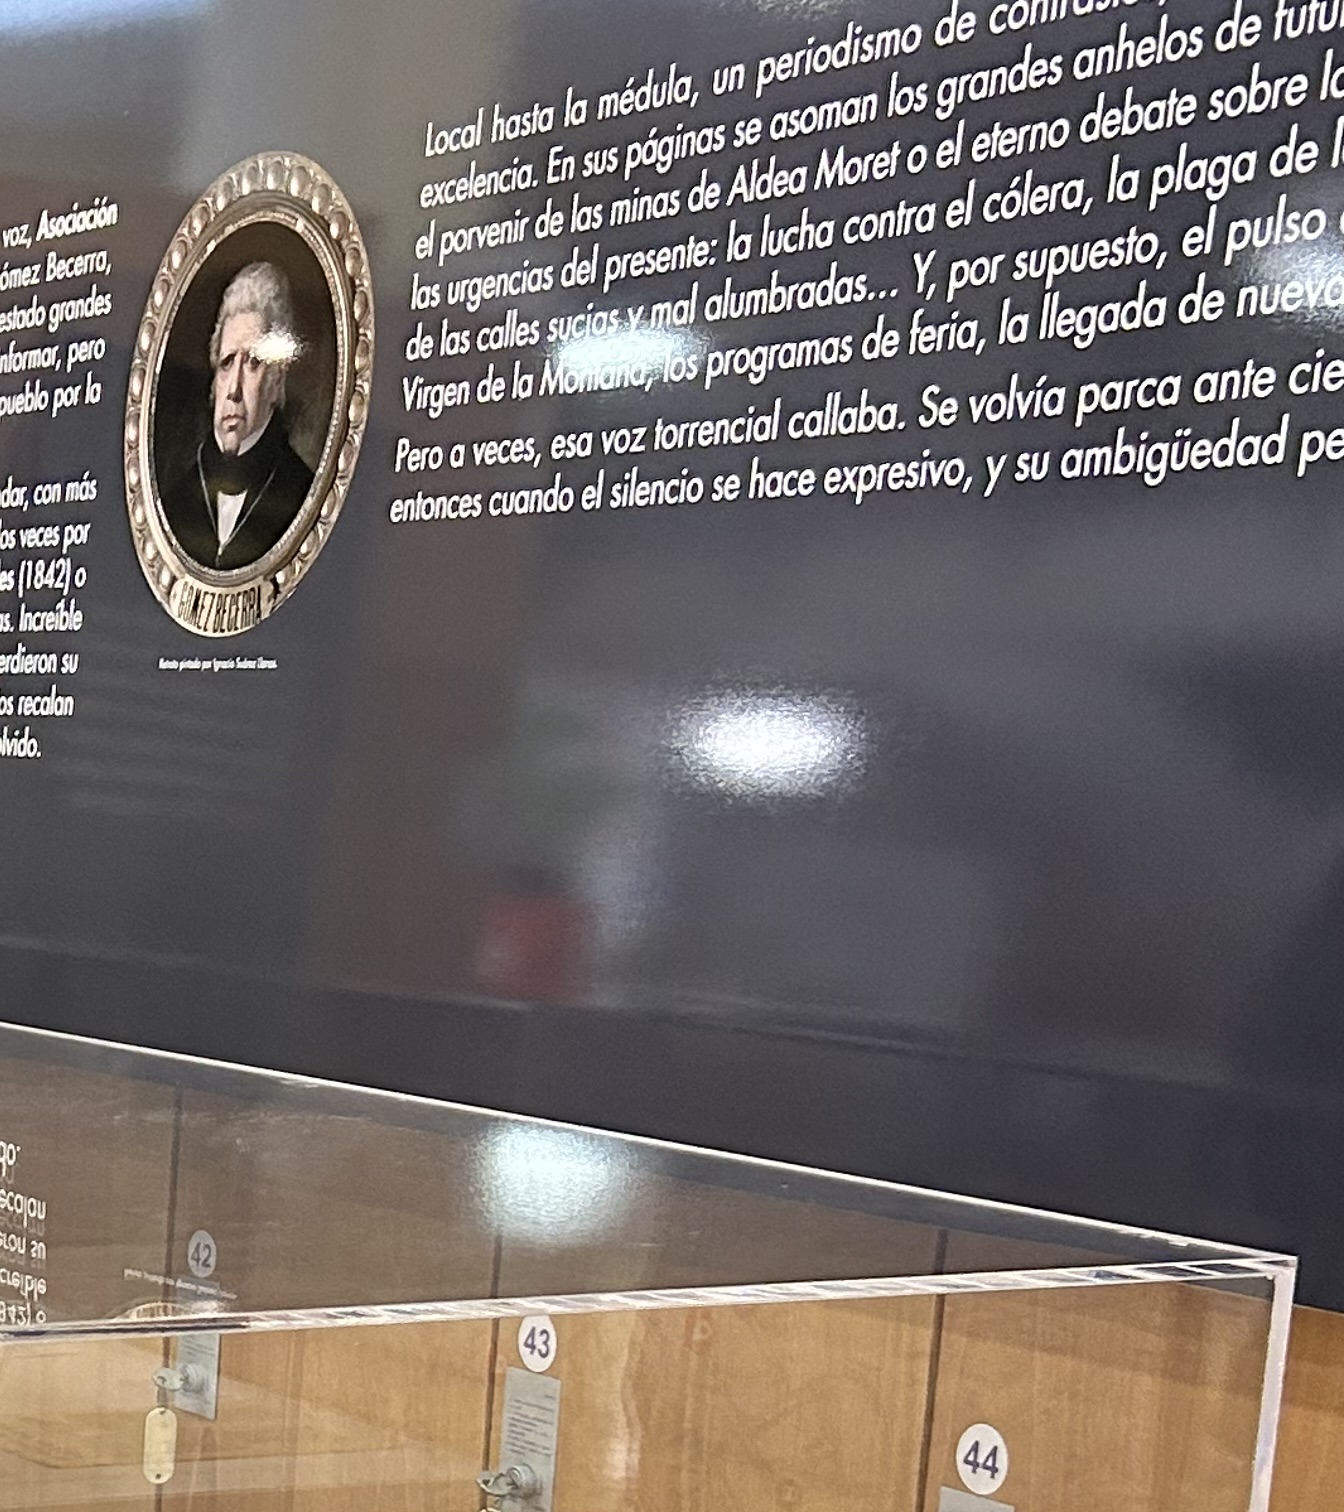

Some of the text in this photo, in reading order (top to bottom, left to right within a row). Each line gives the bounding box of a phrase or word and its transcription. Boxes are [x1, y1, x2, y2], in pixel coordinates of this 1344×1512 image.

[425, 108, 483, 155] Local
[491, 104, 553, 141] hasta
[564, 87, 587, 126] la
[598, 64, 697, 118] médula,
[713, 64, 744, 94] un
[756, 23, 920, 95] periodismo
[935, 0, 975, 45] de
[420, 158, 537, 206] excelencia.
[547, 146, 574, 183] En
[582, 147, 617, 176] sus
[625, 124, 724, 178] páginas
[733, 118, 761, 146] se
[770, 94, 877, 138] asoman
[887, 72, 927, 116] los
[936, 44, 1061, 118] grandes
[1073, 15, 1202, 78] anhelos
[1215, 0, 1261, 50] de
[415, 63, 1307, 265] el porvenir de las minas de Aldea Moret o el eterno debate sobre
[2, 223, 33, 249] voz,
[35, 195, 118, 241] Asociación
[411, 124, 1318, 311] las urgencias del presente: la lucha contra el cólera, la plaga de
[45, 250, 112, 281] Becerra,
[406, 198, 1329, 360] de las calles sucias y mal alumbradas... Y, por supuesto, el pulso
[48, 283, 112, 334] grandes
[66, 337, 106, 373] pero
[403, 377, 470, 417] Virgen
[477, 363, 504, 402] de
[511, 360, 533, 399] la
[663, 348, 698, 383] los
[704, 333, 853, 389] programas
[862, 314, 899, 359] de
[909, 309, 984, 353] feria,
[998, 298, 1028, 343] la
[1040, 282, 1165, 347] llegada
[1178, 273, 1224, 322] de
[51, 384, 82, 418] por
[84, 370, 102, 405] la
[395, 438, 445, 471] Pero
[449, 444, 467, 467] a
[473, 438, 540, 466] veces,
[551, 432, 592, 458] esa
[601, 427, 646, 453] voz
[654, 399, 780, 448] torrencial
[788, 390, 904, 437] callaba.
[919, 385, 957, 426] Se
[969, 374, 1064, 421] volvía
[1076, 376, 1180, 425] parca
[1194, 360, 1275, 401] ante
[33, 482, 62, 505] con
[65, 470, 97, 502] más
[390, 492, 481, 521] entonces
[489, 473, 573, 514] cuando
[581, 469, 603, 509] el
[610, 467, 702, 506] silencio
[711, 474, 740, 500] se
[749, 457, 815, 497] hace
[824, 450, 971, 502] expresivo,
[984, 454, 1007, 496] y
[1015, 452, 1049, 480] su
[1061, 416, 1288, 483] ambigüedad
[19, 521, 92, 554] veces por
[18, 557, 72, 598] (1842)
[74, 566, 87, 588] o
[18, 598, 84, 632] Increíble
[17, 684, 75, 716] recalan
[191, 1242, 212, 1268] 42
[524, 1326, 550, 1358] 43
[963, 1440, 999, 1479] 44
